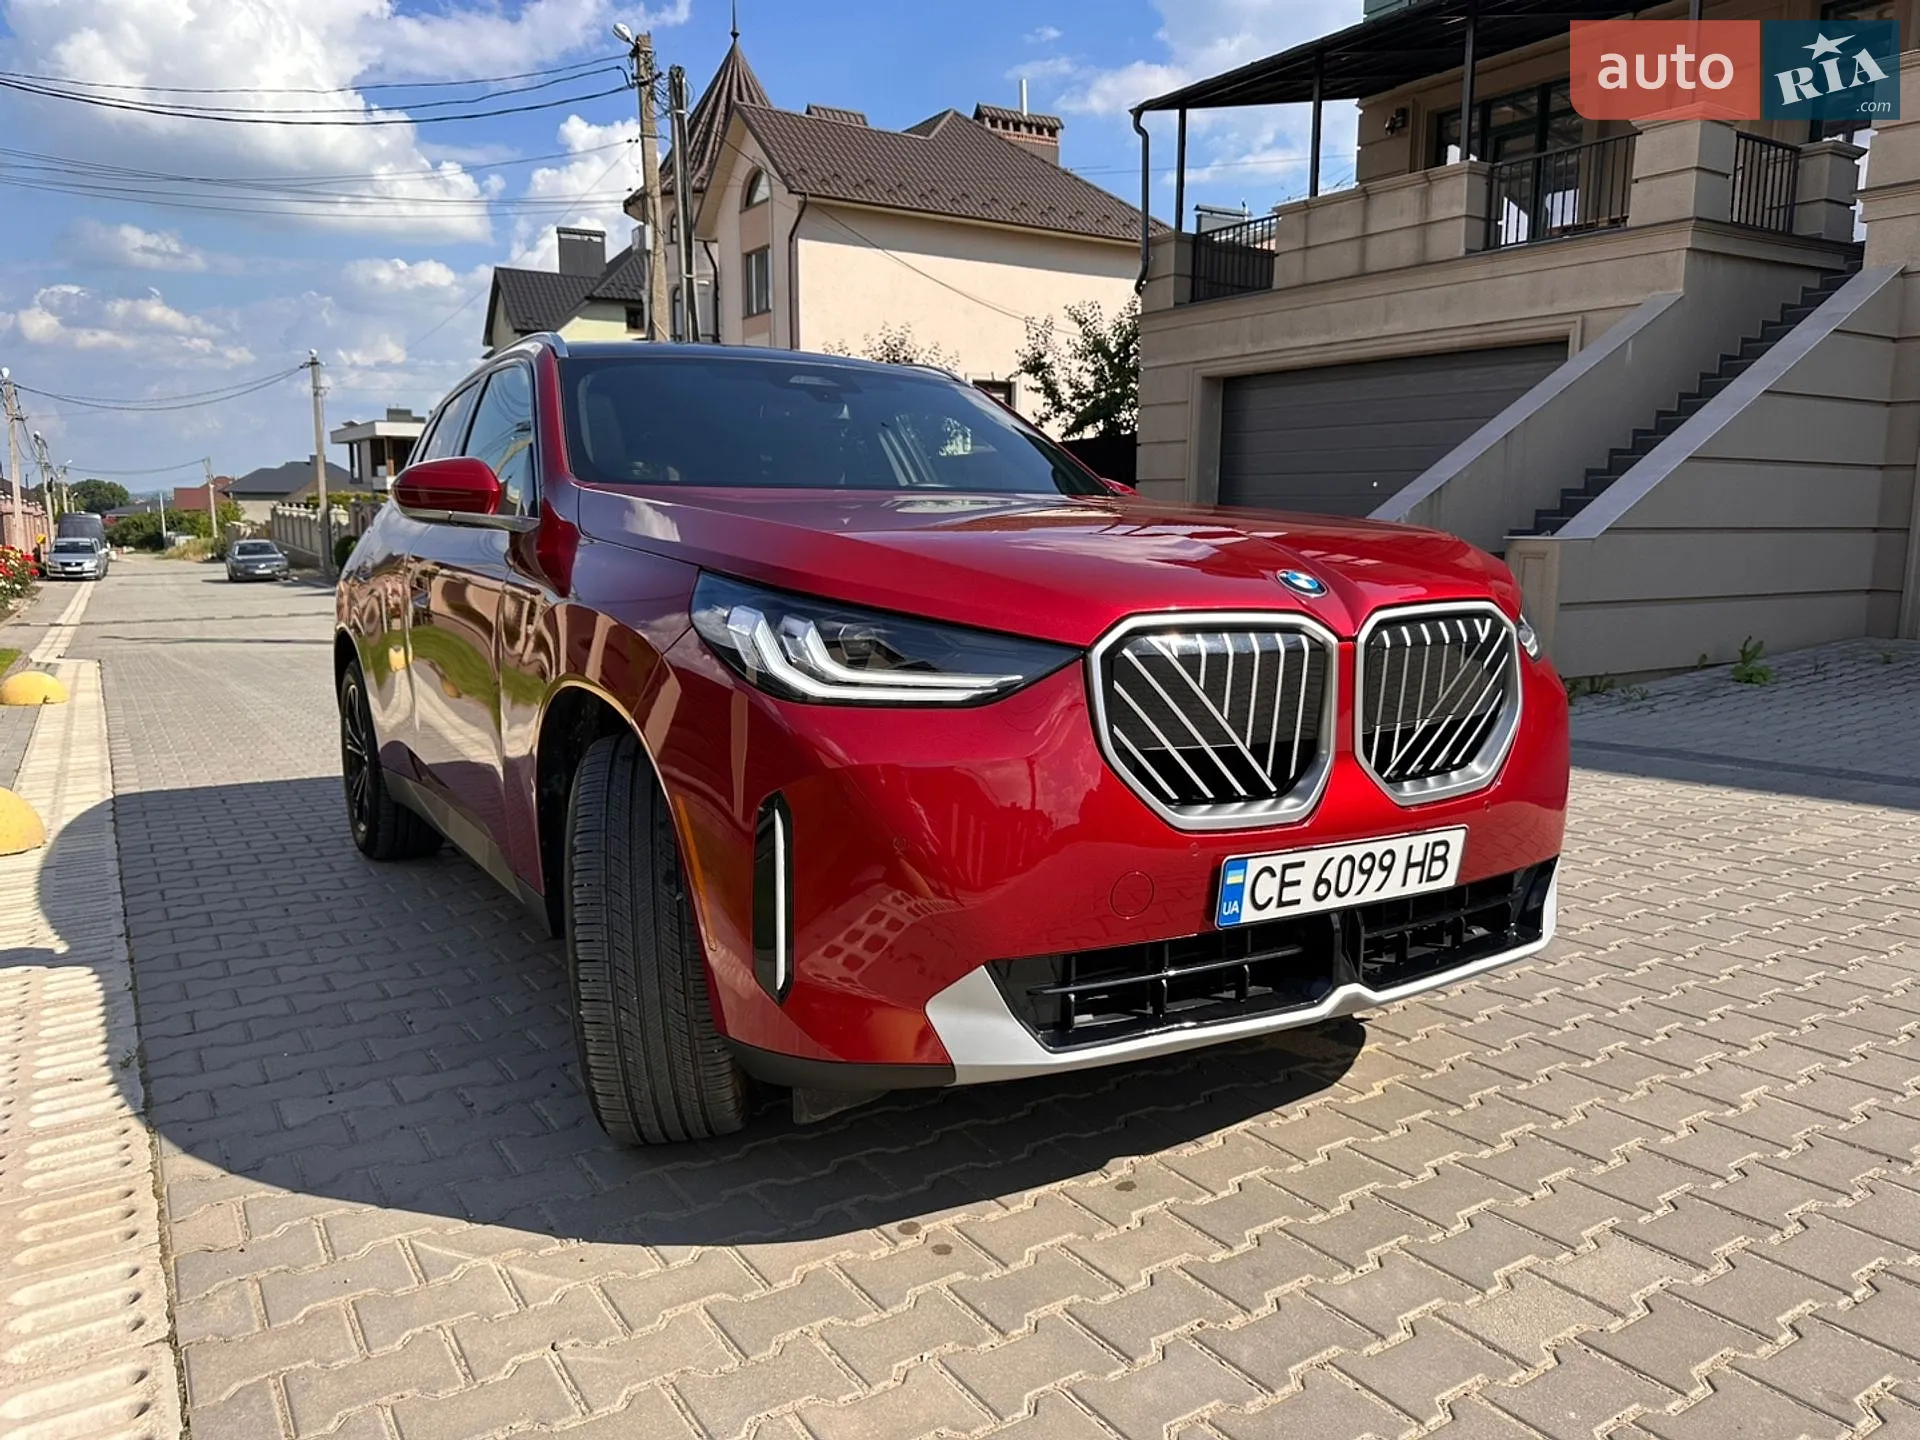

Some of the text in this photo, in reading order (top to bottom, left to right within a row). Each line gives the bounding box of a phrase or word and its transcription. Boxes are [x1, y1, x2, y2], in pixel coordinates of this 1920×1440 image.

[1250, 839, 1451, 911] CE 6099 HB
[1222, 901, 1239, 915] UA
